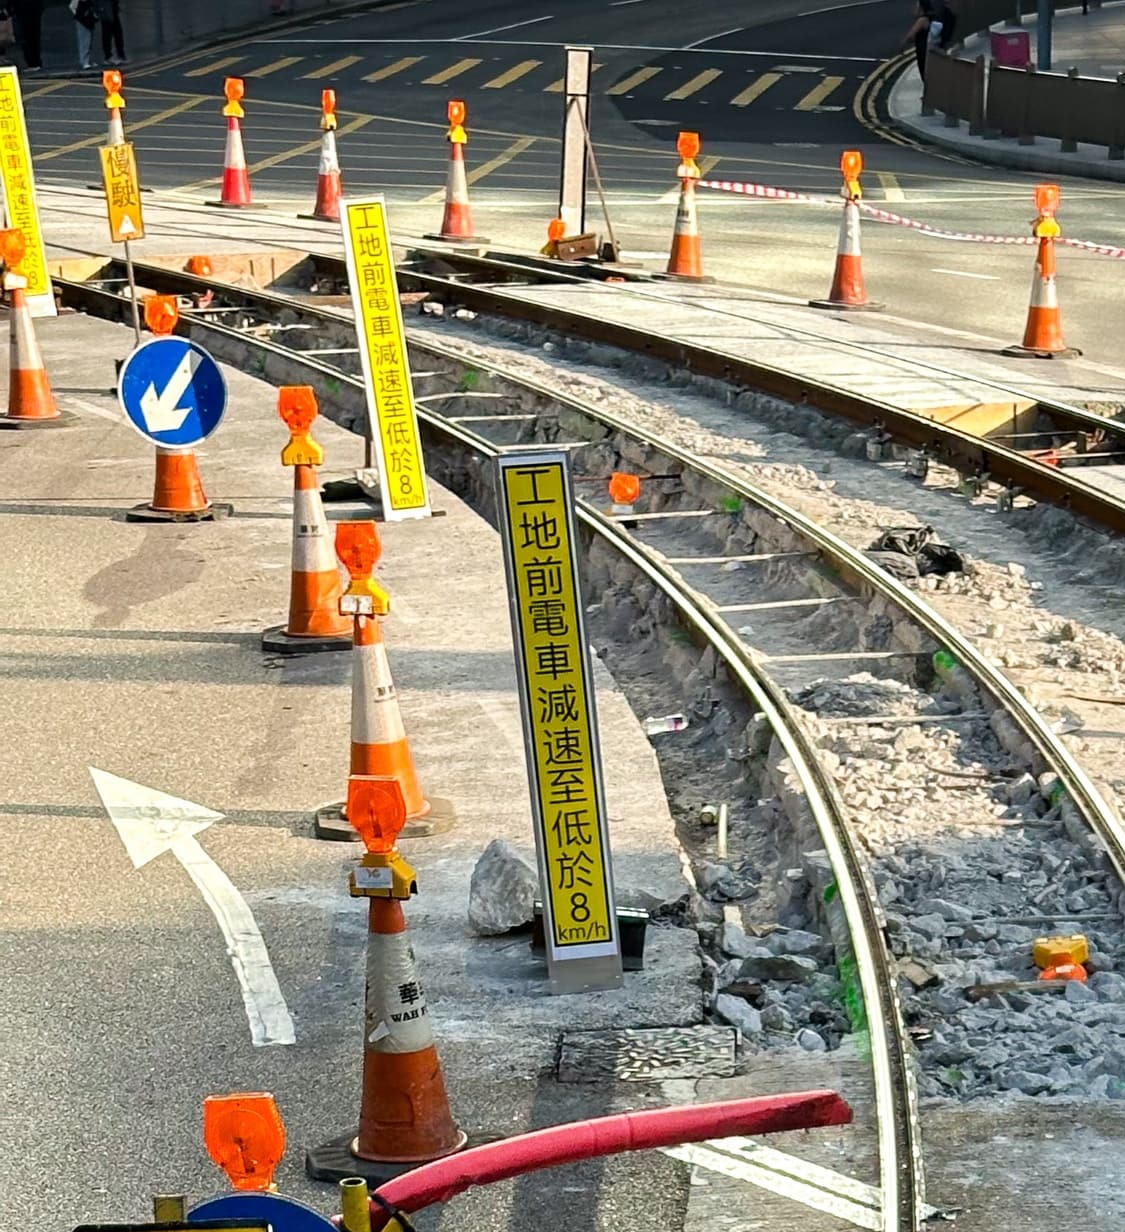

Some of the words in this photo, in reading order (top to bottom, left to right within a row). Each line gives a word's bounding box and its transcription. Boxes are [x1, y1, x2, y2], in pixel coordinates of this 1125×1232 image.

[107, 150, 136, 208] 慢駛
[557, 922, 606, 942] km/h
[390, 1009, 419, 1023] WAH
